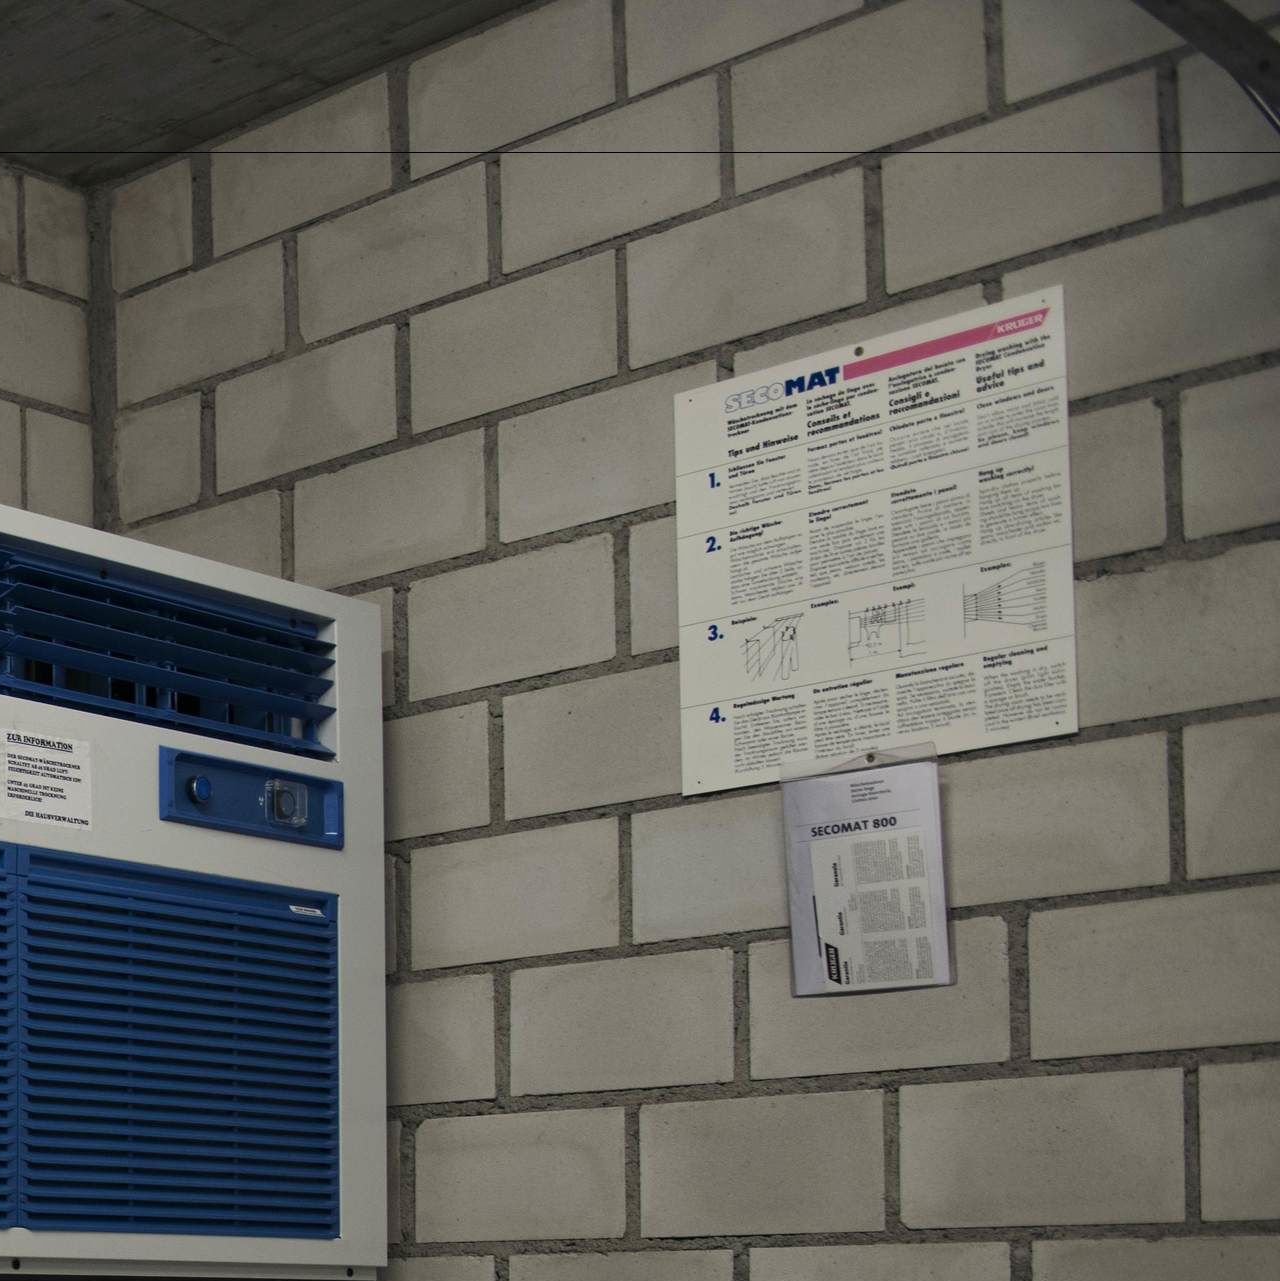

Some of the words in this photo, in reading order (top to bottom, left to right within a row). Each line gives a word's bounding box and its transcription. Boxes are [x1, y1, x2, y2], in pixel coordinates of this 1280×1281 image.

[976, 369, 1004, 384] Useful
[1007, 366, 1024, 376] tips
[1027, 358, 1045, 371] and
[725, 367, 840, 414] SECOMAT
[976, 380, 1005, 393] advice
[888, 391, 922, 407] Consigli
[807, 413, 840, 428] Conseils
[842, 410, 851, 419] et
[728, 448, 743, 458] Tips
[745, 442, 760, 453] und
[762, 434, 799, 448] Hinweise
[708, 472, 721, 489] 1.
[706, 536, 722, 554] 2.
[707, 624, 725, 642] 3.
[709, 706, 727, 724] 4.
[7, 733, 22, 741] ZUR
[23, 736, 73, 750] INFORMATION
[35, 812, 89, 825] HAUSVERWALTUNG
[811, 819, 869, 838] SECOMAT
[872, 816, 897, 829] 800
